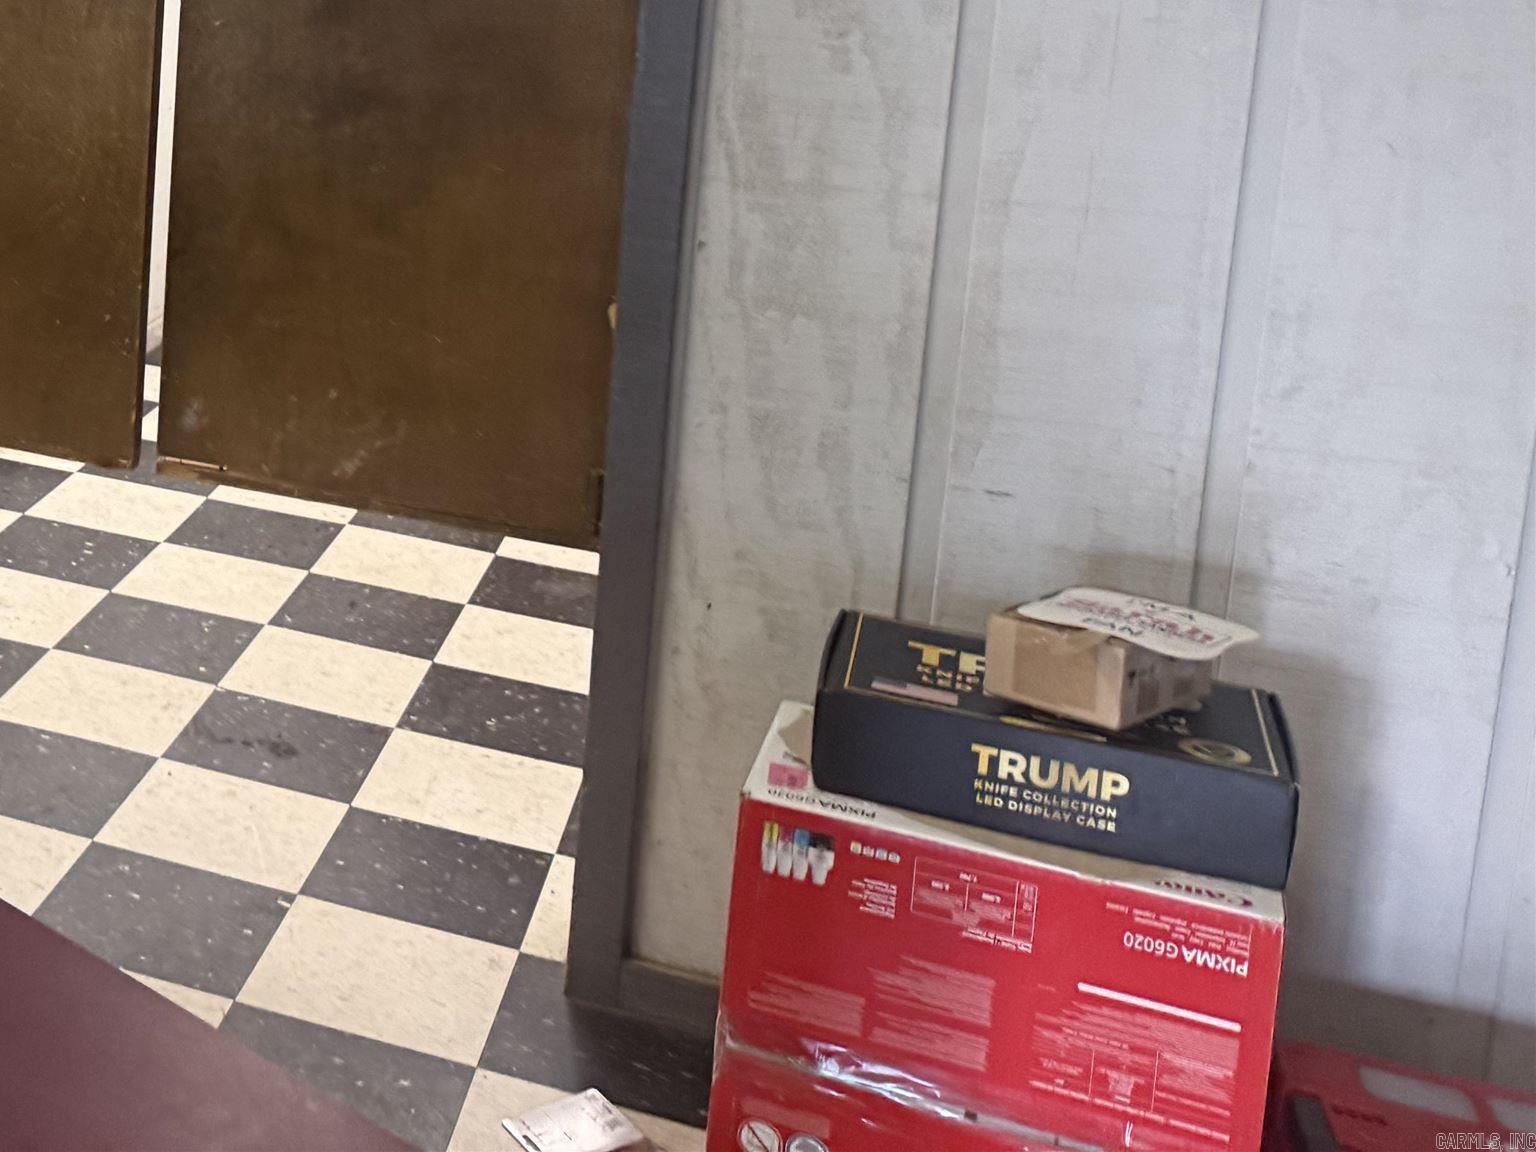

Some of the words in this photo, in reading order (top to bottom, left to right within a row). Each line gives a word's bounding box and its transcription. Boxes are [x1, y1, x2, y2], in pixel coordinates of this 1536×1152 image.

[970, 743, 1131, 802] TRUMP
[974, 778, 1019, 798] KNIFE
[1023, 789, 1117, 819] COLLECTION
[976, 792, 1004, 808] LED
[1008, 800, 1072, 824] DISPLAY
[1076, 814, 1116, 833] CASE
[1123, 930, 1180, 959] G6020
[1181, 945, 1250, 978] PIXMA
